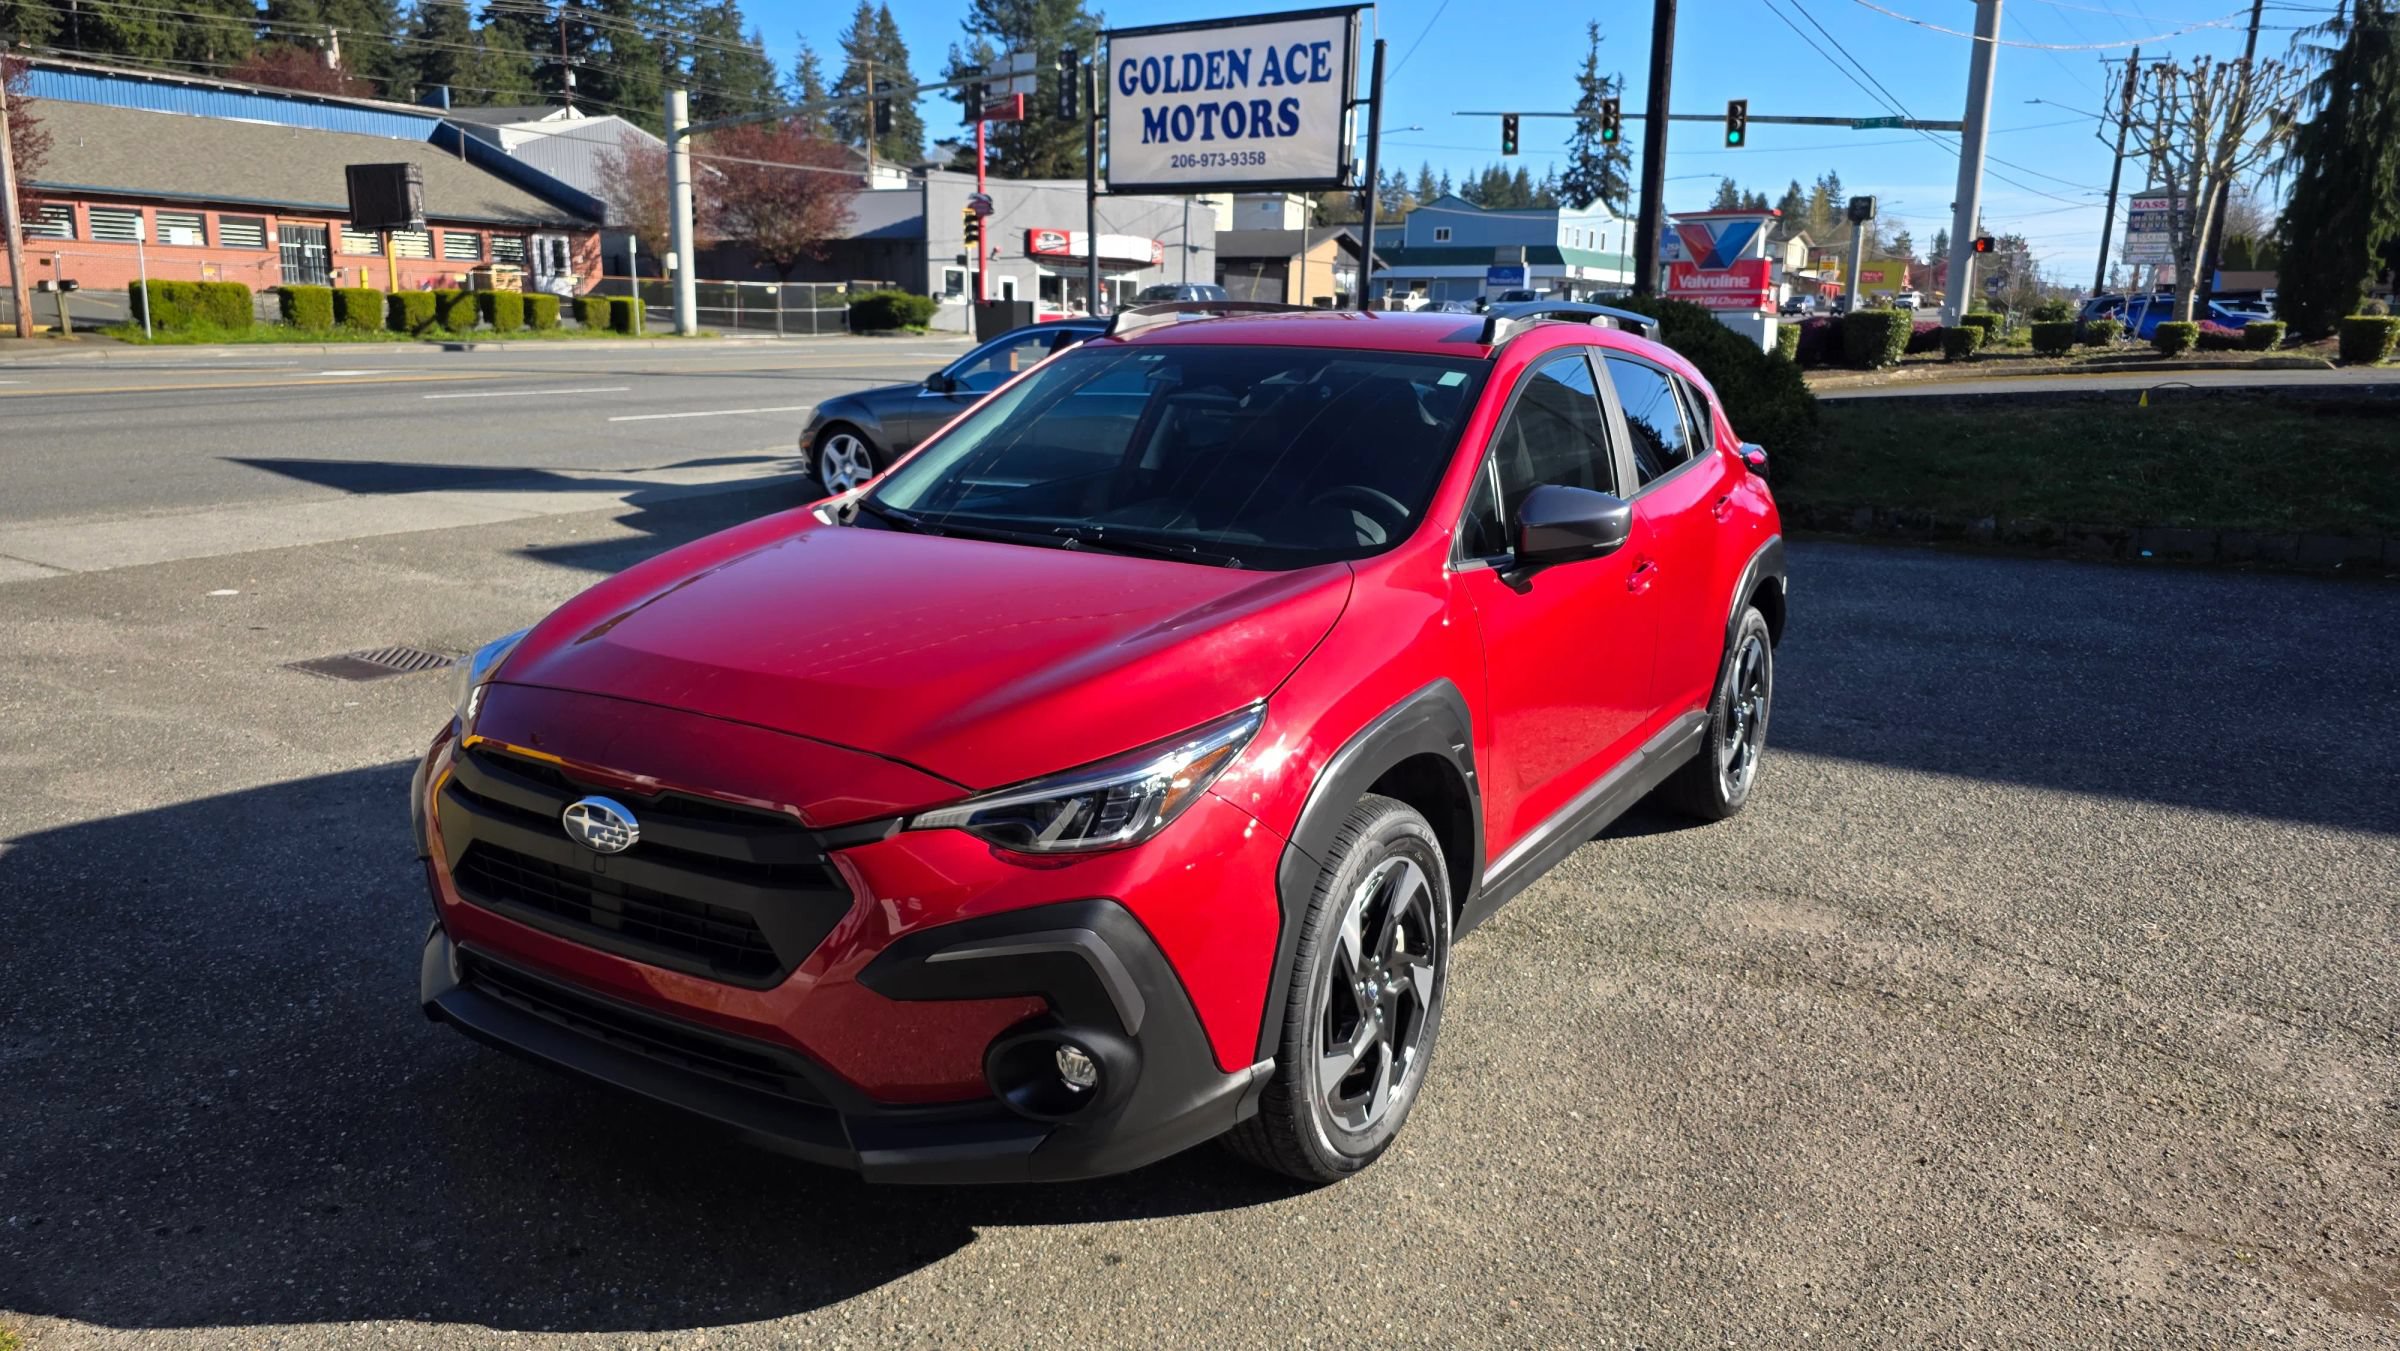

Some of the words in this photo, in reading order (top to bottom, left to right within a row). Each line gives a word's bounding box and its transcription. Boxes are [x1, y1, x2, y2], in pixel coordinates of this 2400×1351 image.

[1118, 48, 1253, 96] GOLDEN
[1258, 41, 1332, 88] ACE
[1142, 97, 1300, 144] MOTORS
[1171, 151, 1267, 168] 206-973-9358
[1679, 274, 1750, 288] Valvoline
